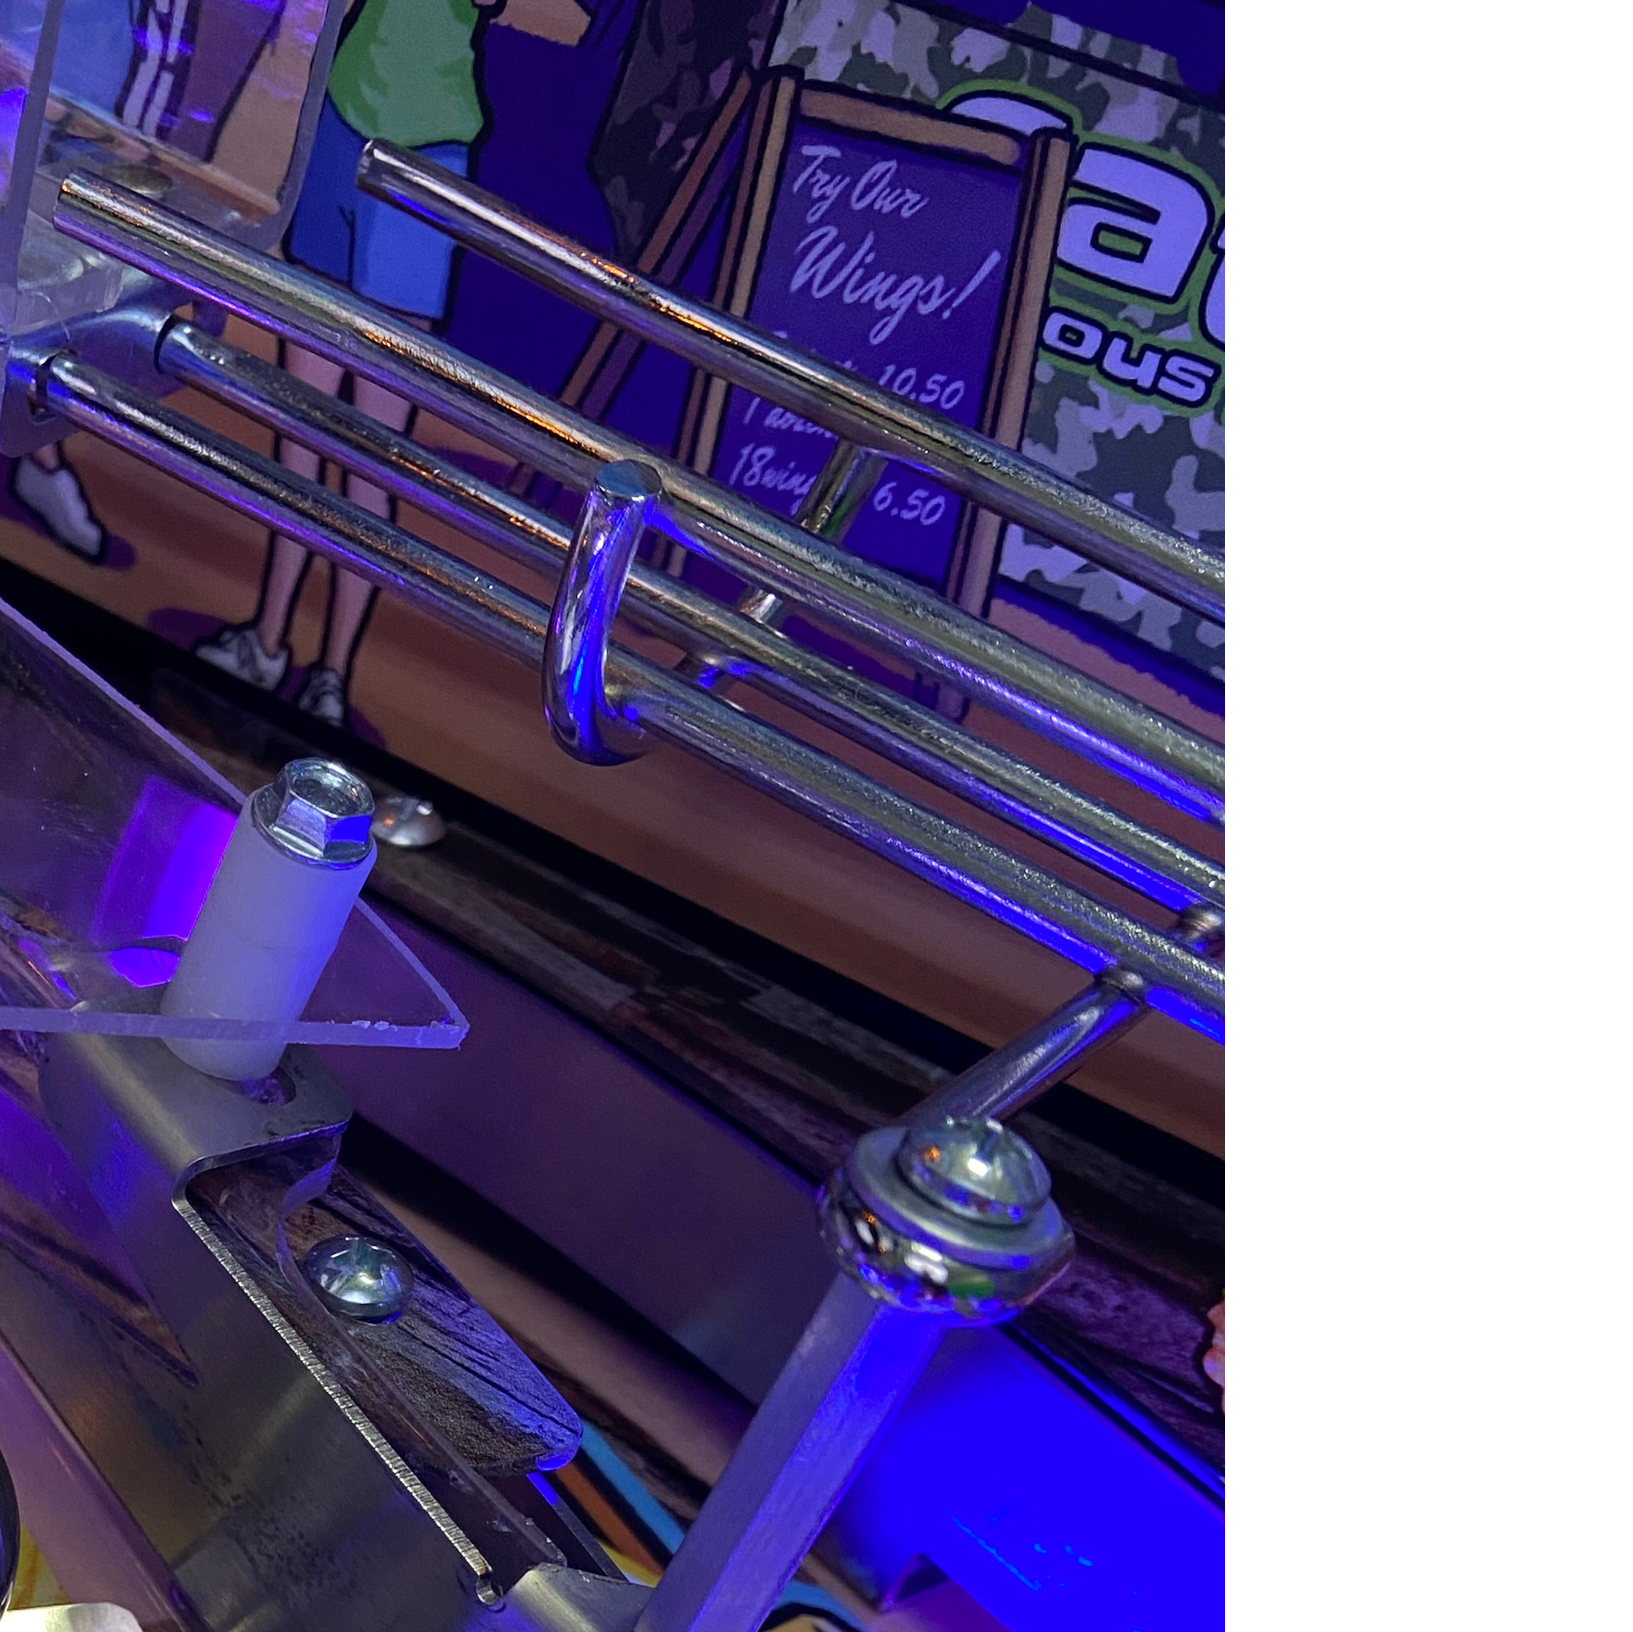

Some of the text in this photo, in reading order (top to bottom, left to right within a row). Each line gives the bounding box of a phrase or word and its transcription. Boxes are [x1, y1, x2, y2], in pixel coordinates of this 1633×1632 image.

[792, 144, 931, 225] Try Our
[788, 224, 1003, 346] Wings!
[876, 363, 966, 411] 10.50
[872, 481, 946, 526] 6.50
